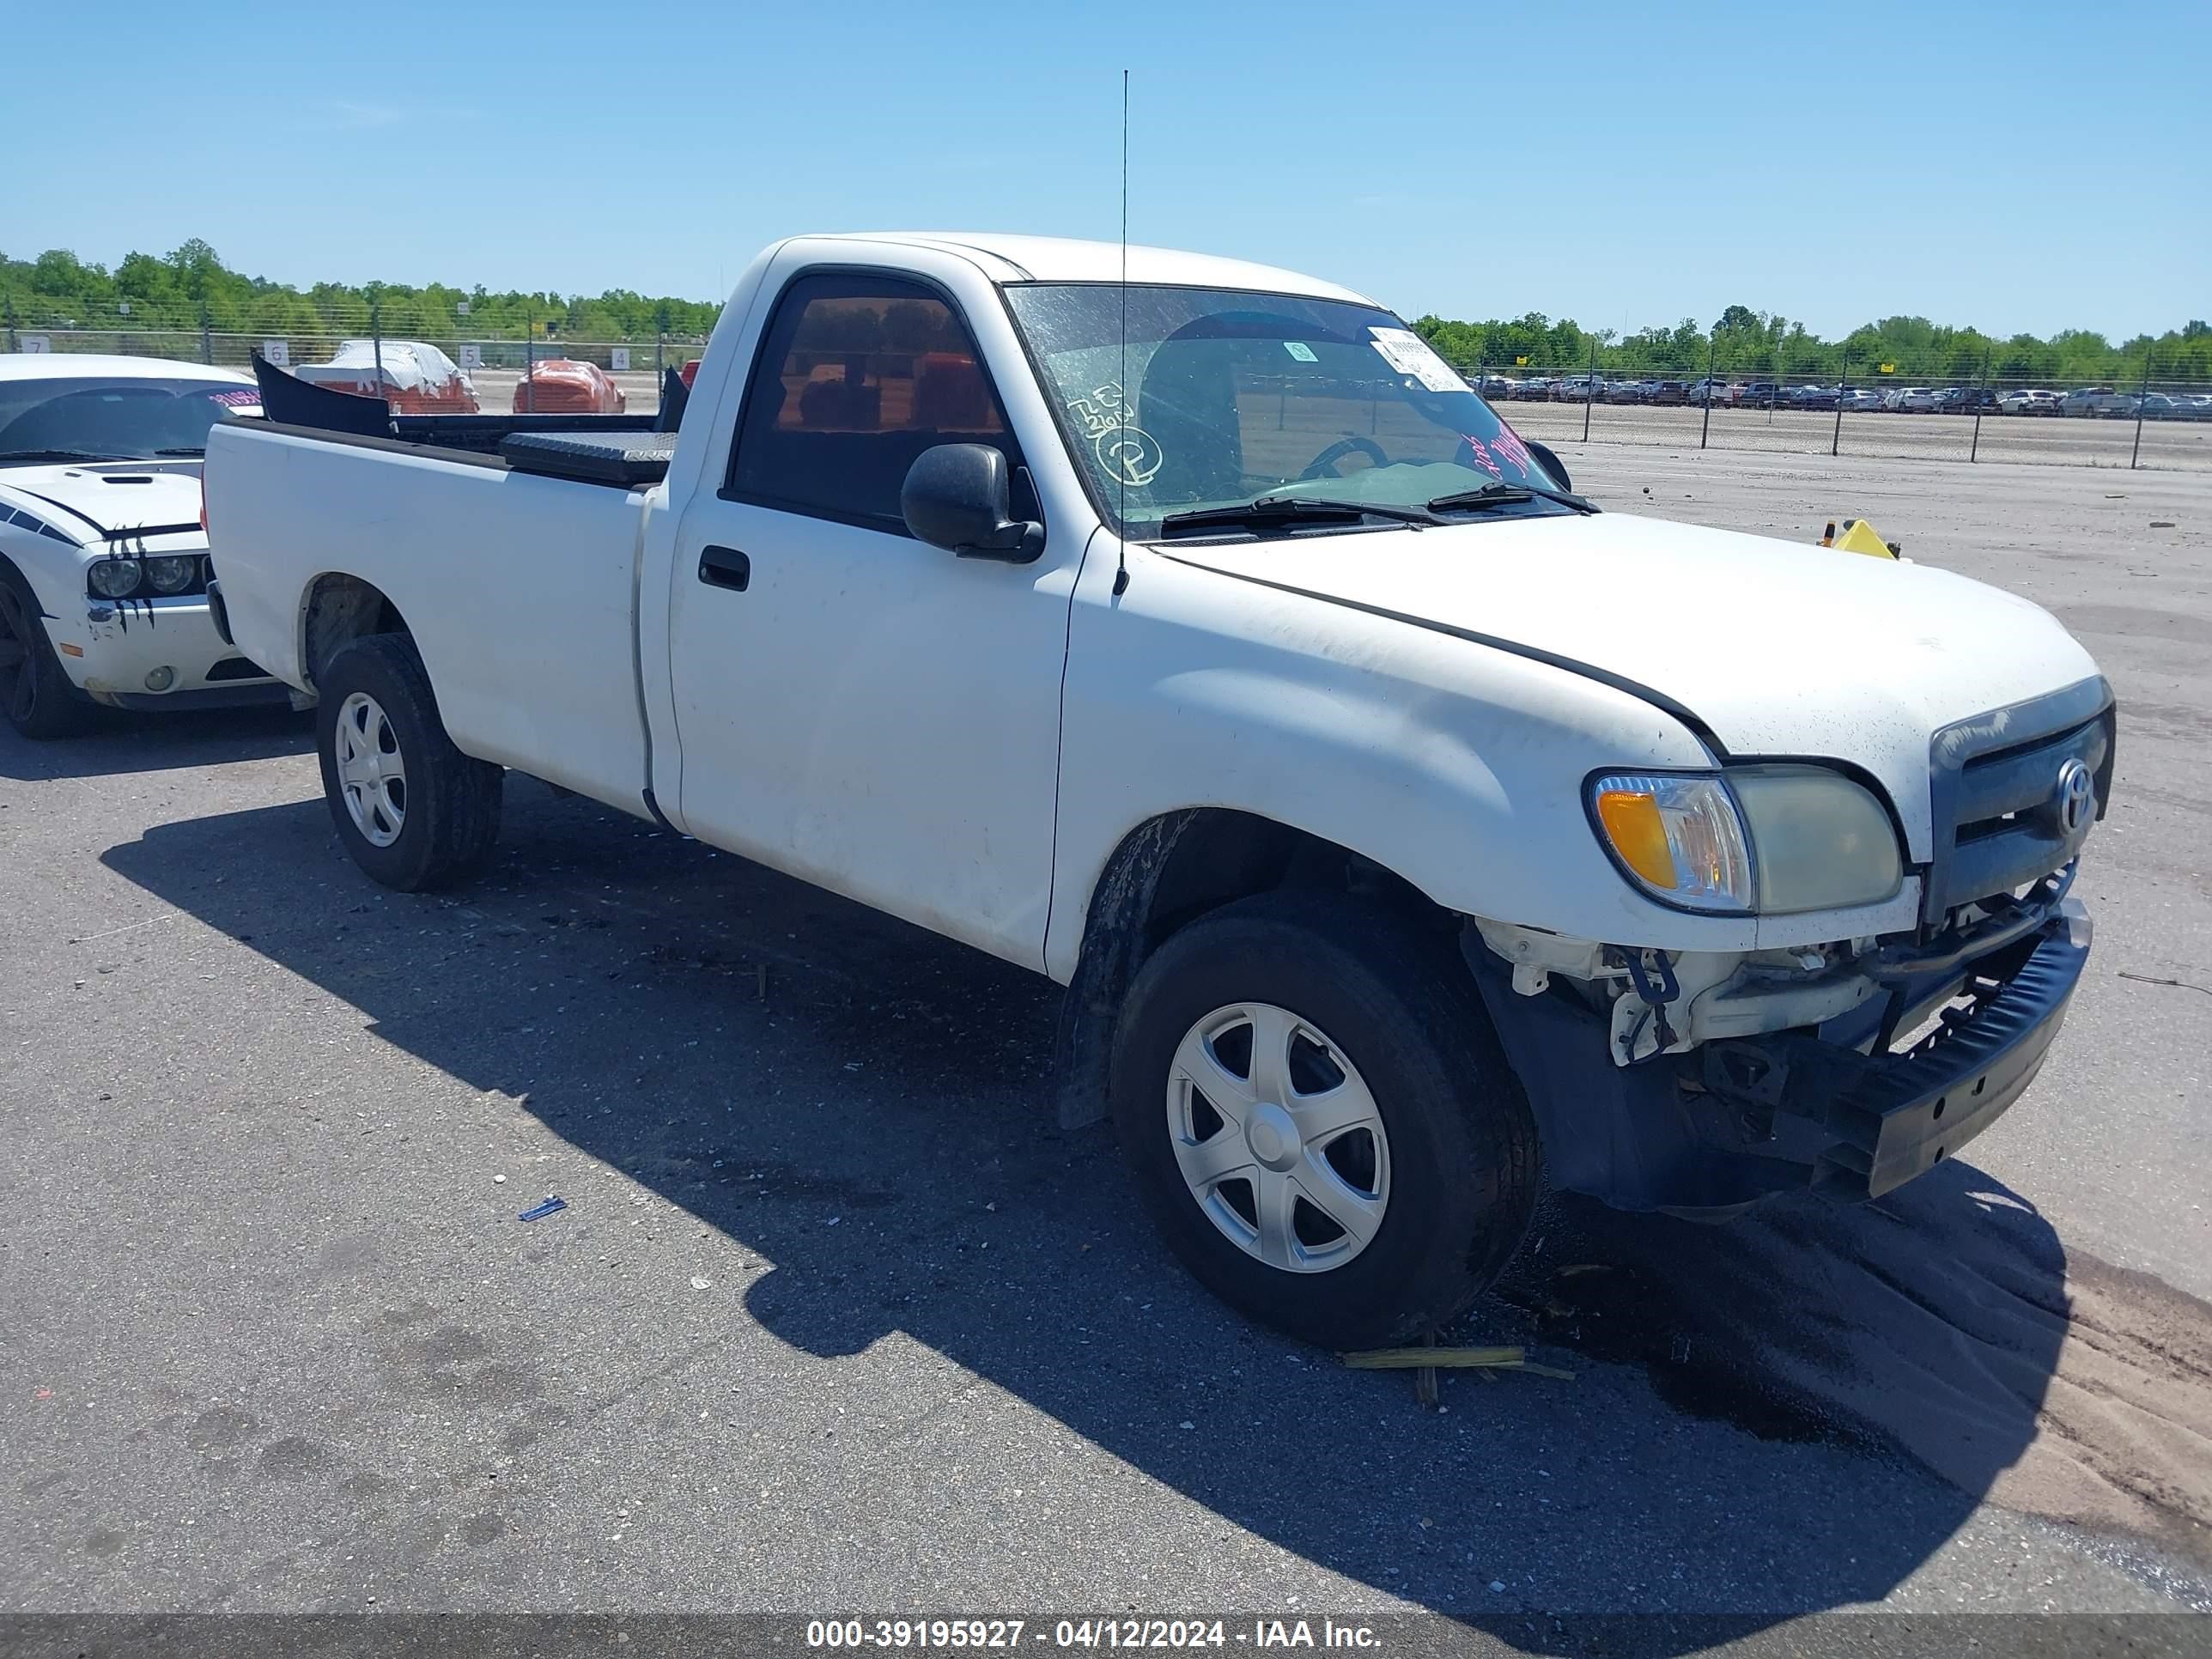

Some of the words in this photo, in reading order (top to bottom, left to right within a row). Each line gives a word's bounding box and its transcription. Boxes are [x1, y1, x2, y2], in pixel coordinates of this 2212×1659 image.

[271, 346, 283, 362] 6
[466, 349, 475, 363] 5
[617, 352, 625, 365] 4
